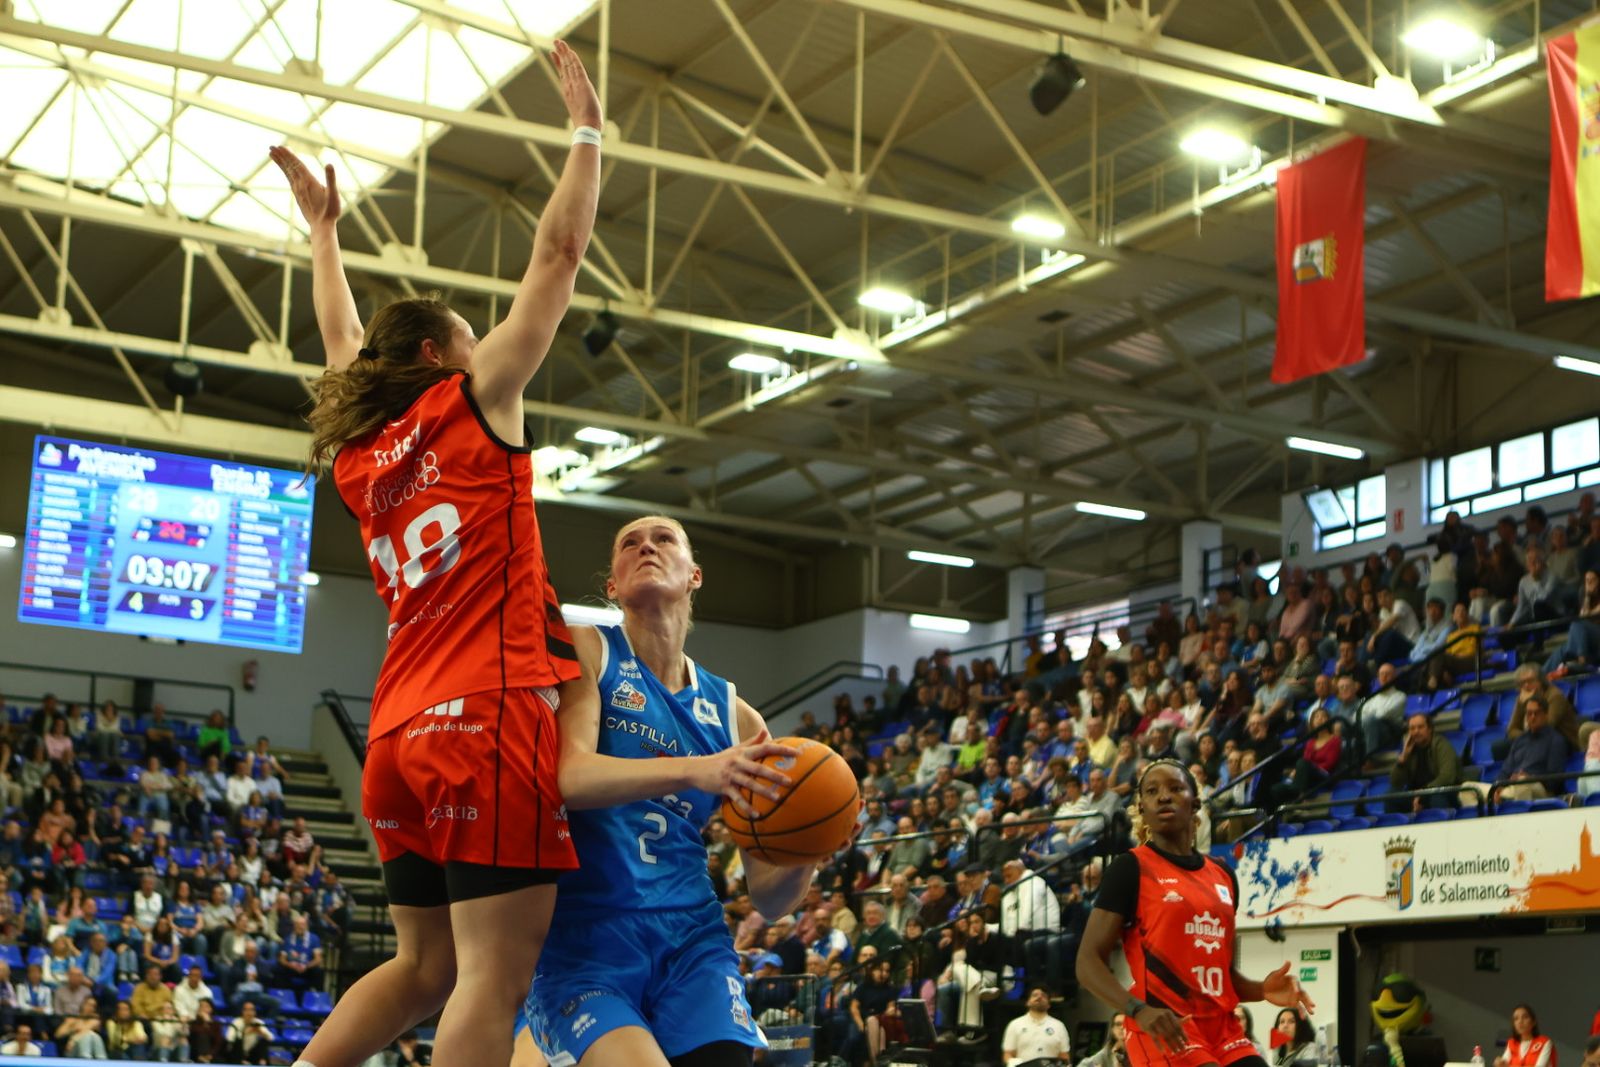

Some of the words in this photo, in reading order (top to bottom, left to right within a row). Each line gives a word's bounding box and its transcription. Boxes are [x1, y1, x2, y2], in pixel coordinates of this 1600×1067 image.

[367, 502, 462, 602] 18
[127, 554, 211, 592] 03:07
[128, 591, 143, 612] 4
[189, 598, 204, 619] 3
[613, 699, 644, 711] AVENIDA
[407, 722, 441, 739] Concello
[443, 721, 456, 731] de
[459, 722, 483, 734] Lugo
[605, 716, 678, 752] CASTILLA
[638, 812, 668, 864] 2
[1420, 854, 1511, 882] Ayuntamiento
[1420, 885, 1435, 904] de
[1439, 882, 1511, 904] Salamanca
[1191, 965, 1224, 997] 10
